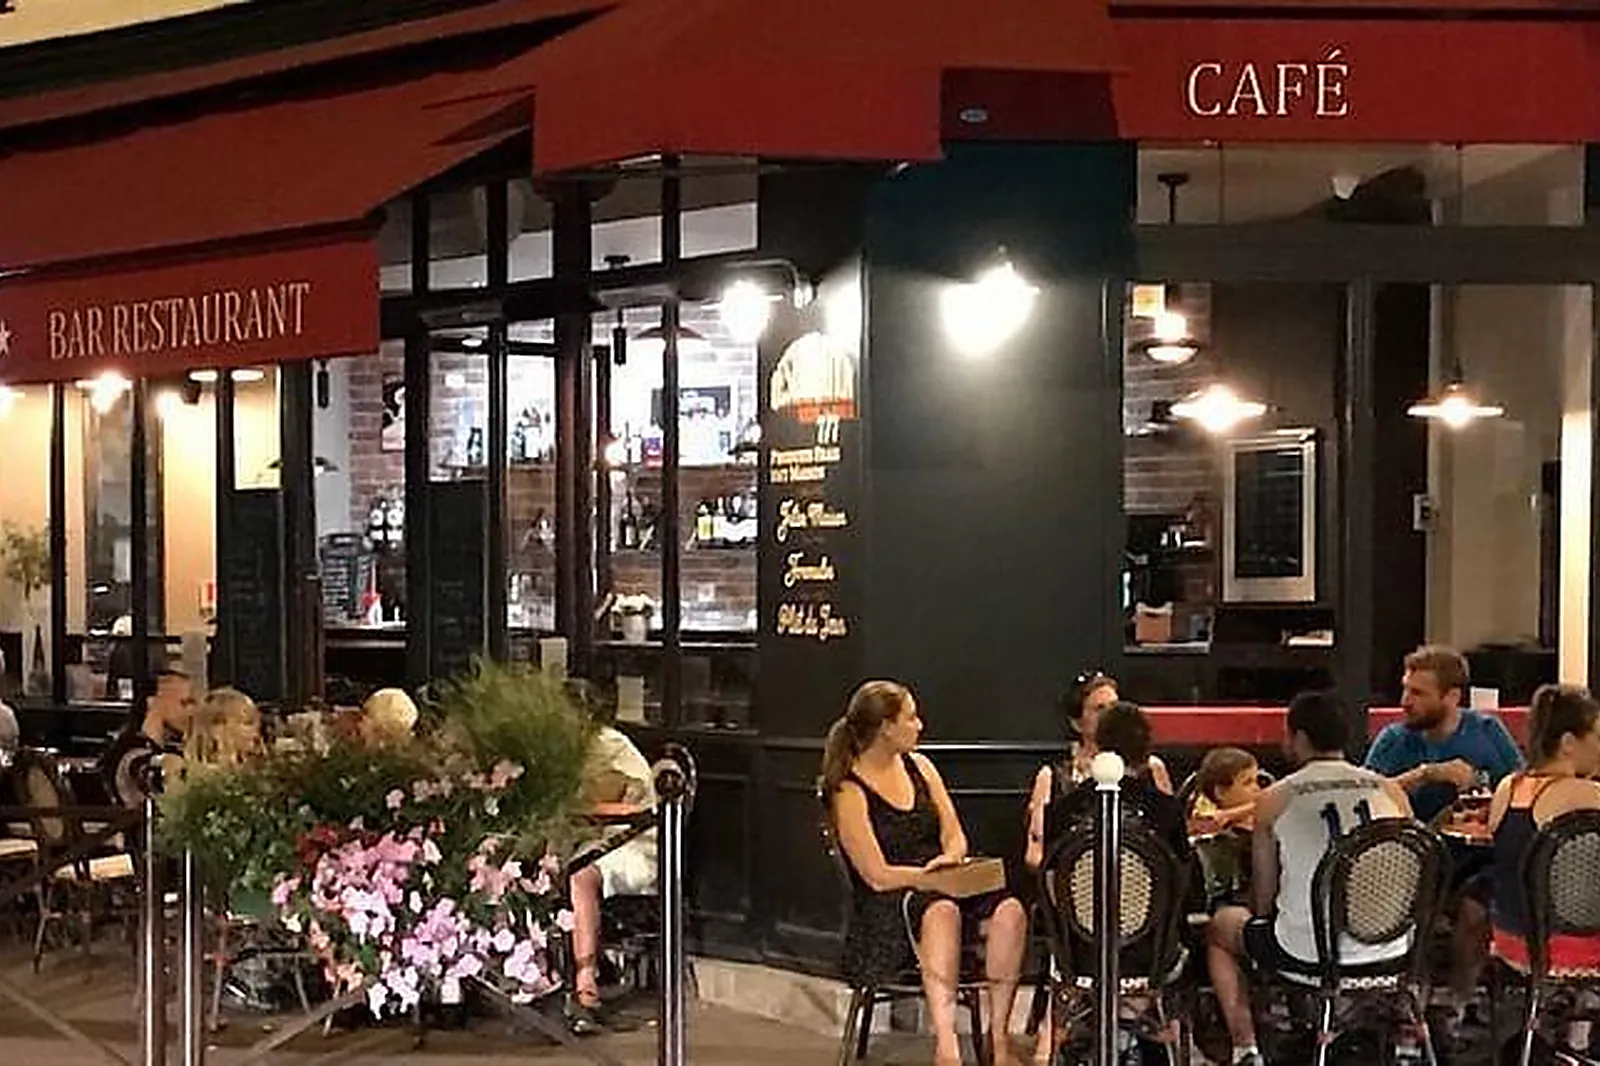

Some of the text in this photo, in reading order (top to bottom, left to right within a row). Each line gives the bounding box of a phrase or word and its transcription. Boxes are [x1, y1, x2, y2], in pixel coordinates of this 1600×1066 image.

[1188, 49, 1348, 116] CAFÉ
[50, 282, 310, 360] BAR RESTAURANT
